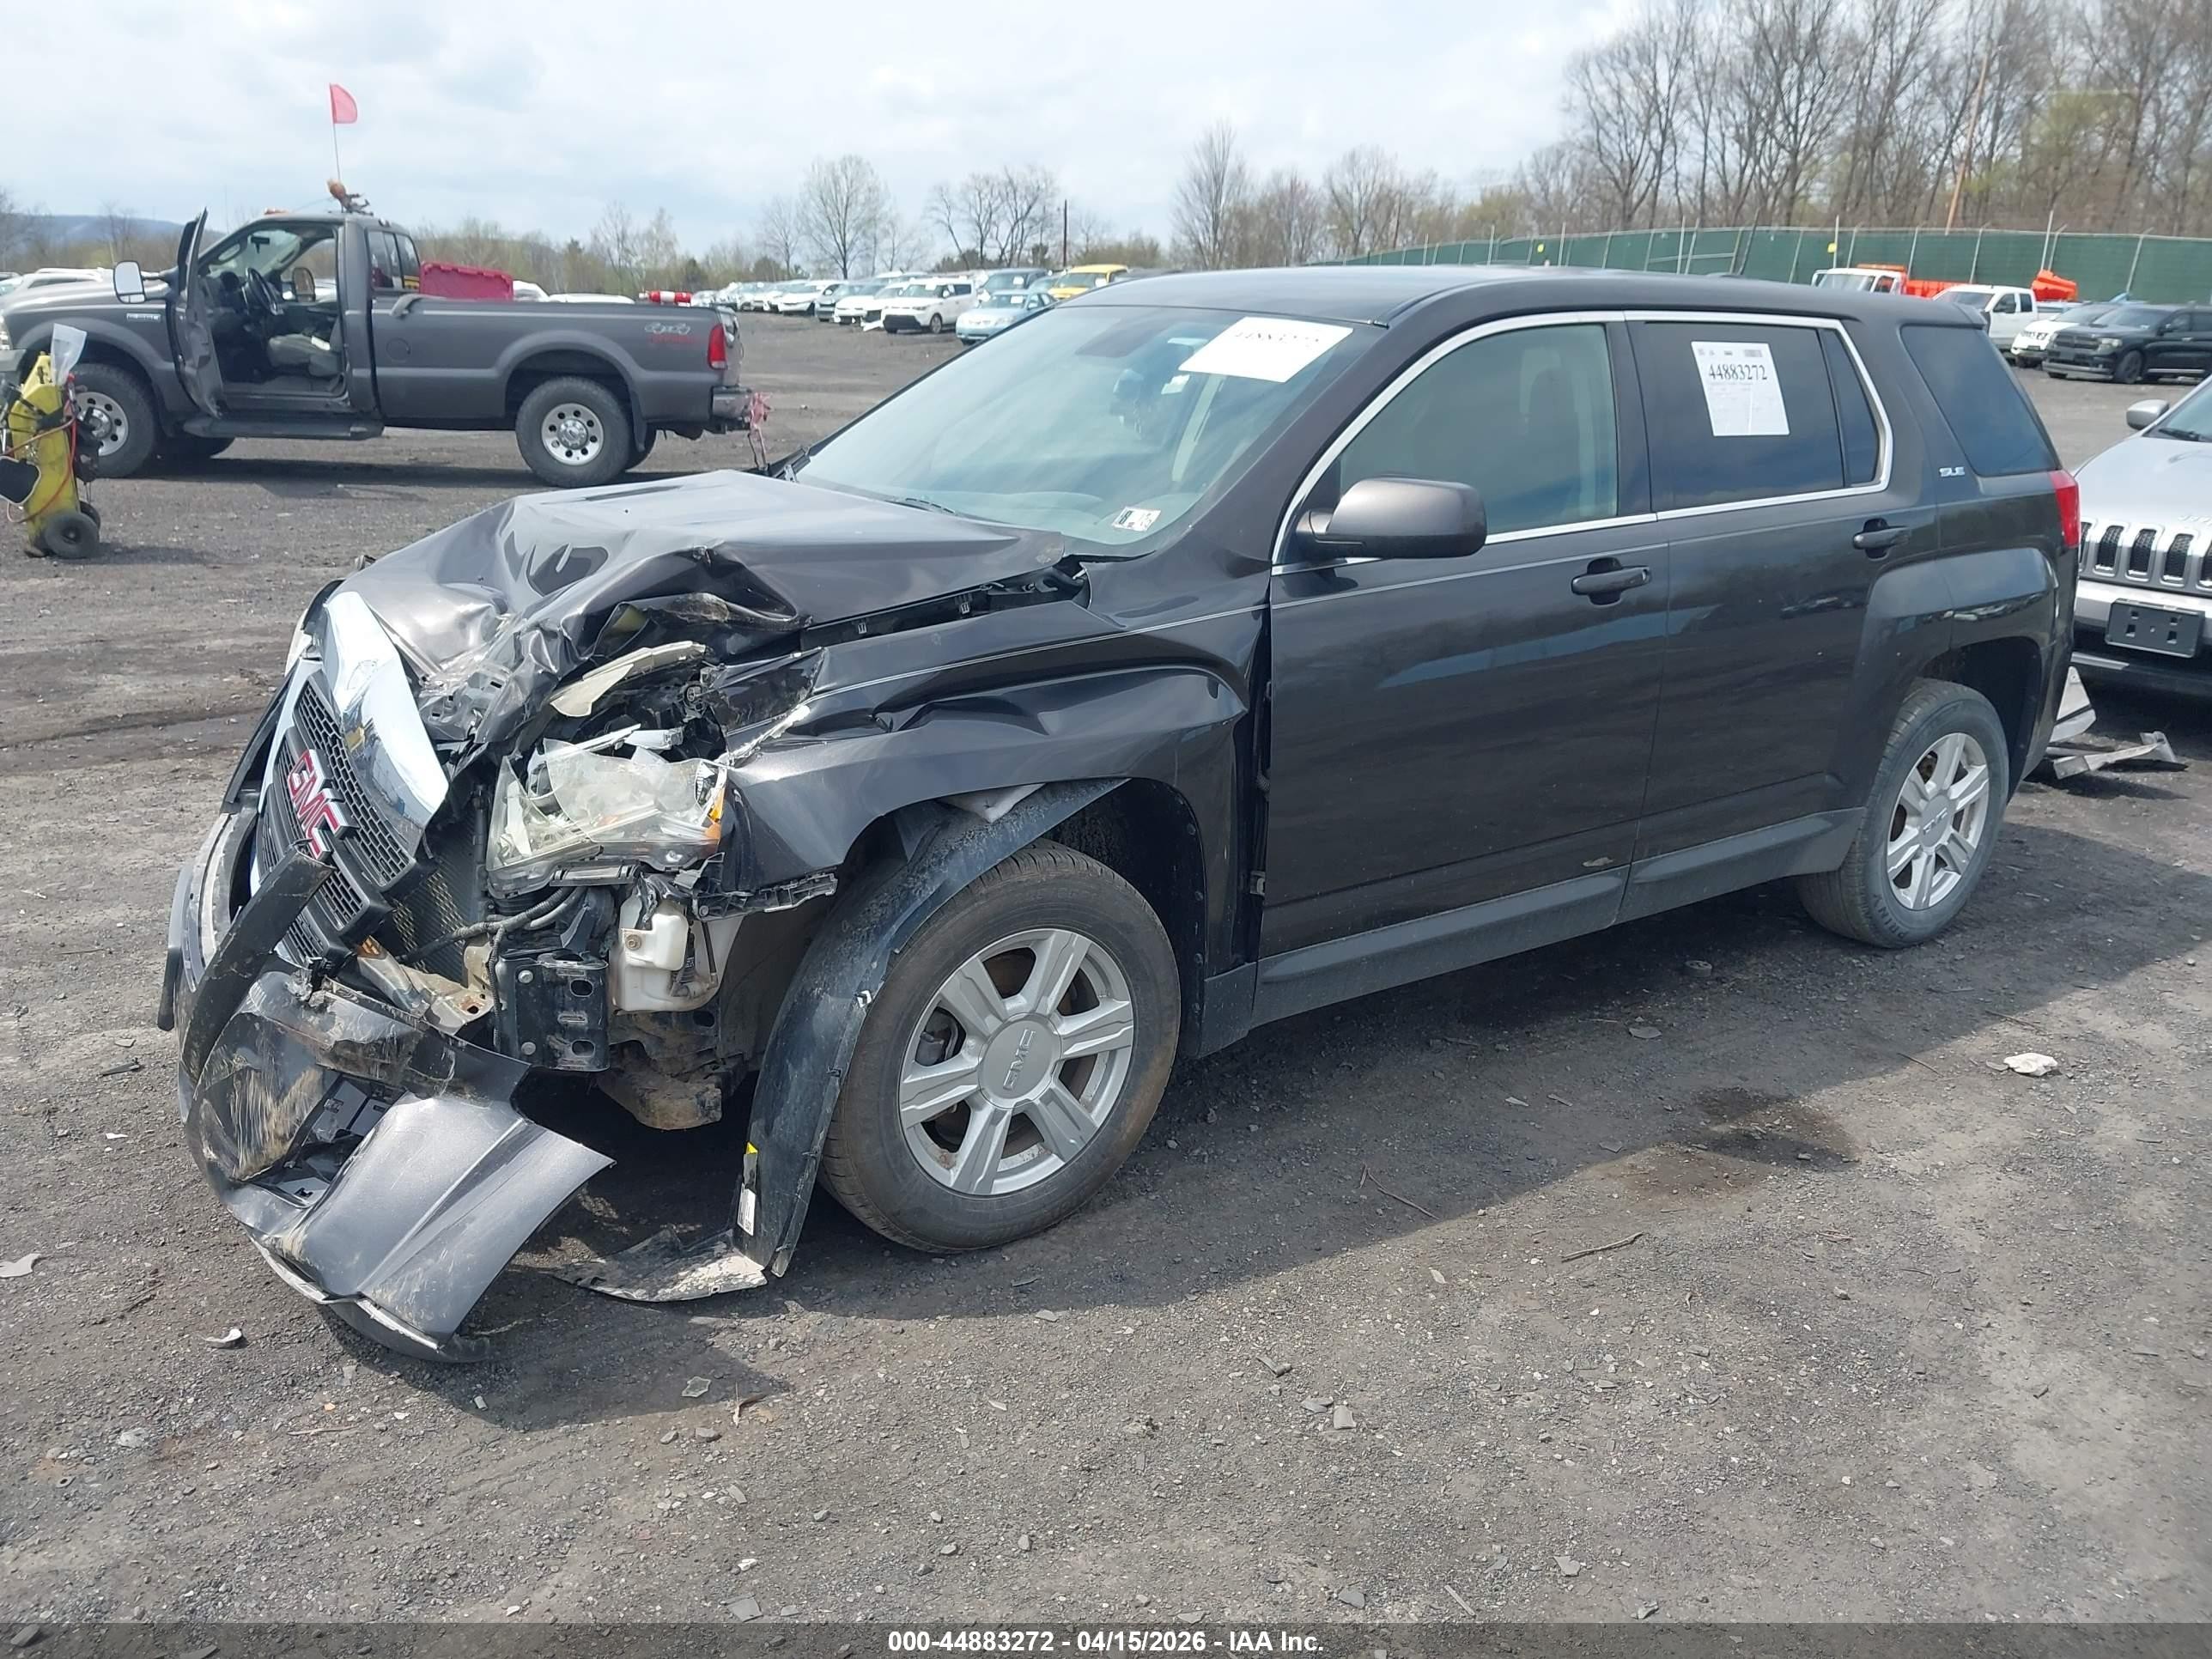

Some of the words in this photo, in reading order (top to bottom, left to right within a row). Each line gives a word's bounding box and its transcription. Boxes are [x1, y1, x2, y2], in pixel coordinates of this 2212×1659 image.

[1708, 364, 1768, 380] 44883272
[287, 749, 349, 860] GMC
[1003, 1029, 1036, 1091] GMC
